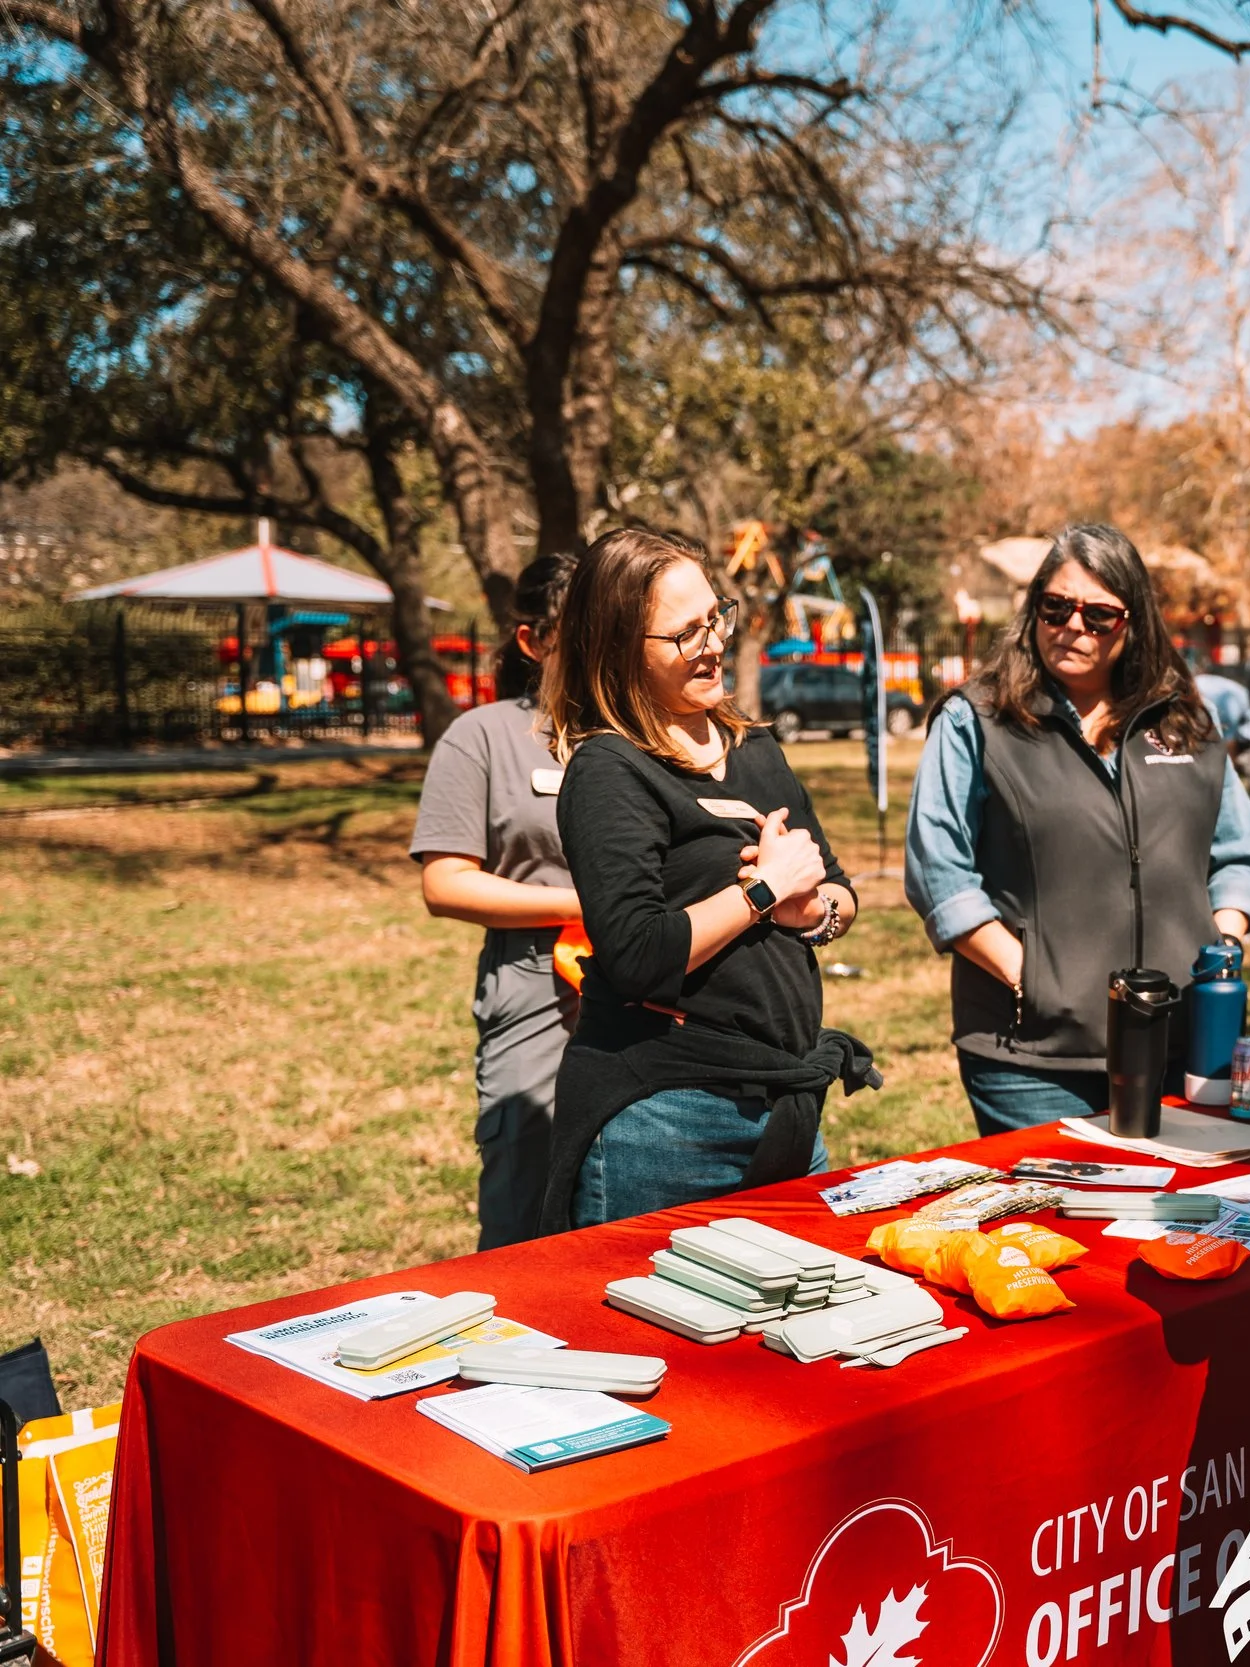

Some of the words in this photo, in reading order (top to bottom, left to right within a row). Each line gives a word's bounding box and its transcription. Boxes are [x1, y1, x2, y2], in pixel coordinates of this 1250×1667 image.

[259, 1321, 311, 1338] CLIMATE
[312, 1311, 353, 1326] READY
[1031, 1496, 1114, 1577] CITY
[1123, 1475, 1169, 1542] OF
[1179, 1447, 1245, 1522] SAN
[1026, 1543, 1202, 1667] OFFICE
